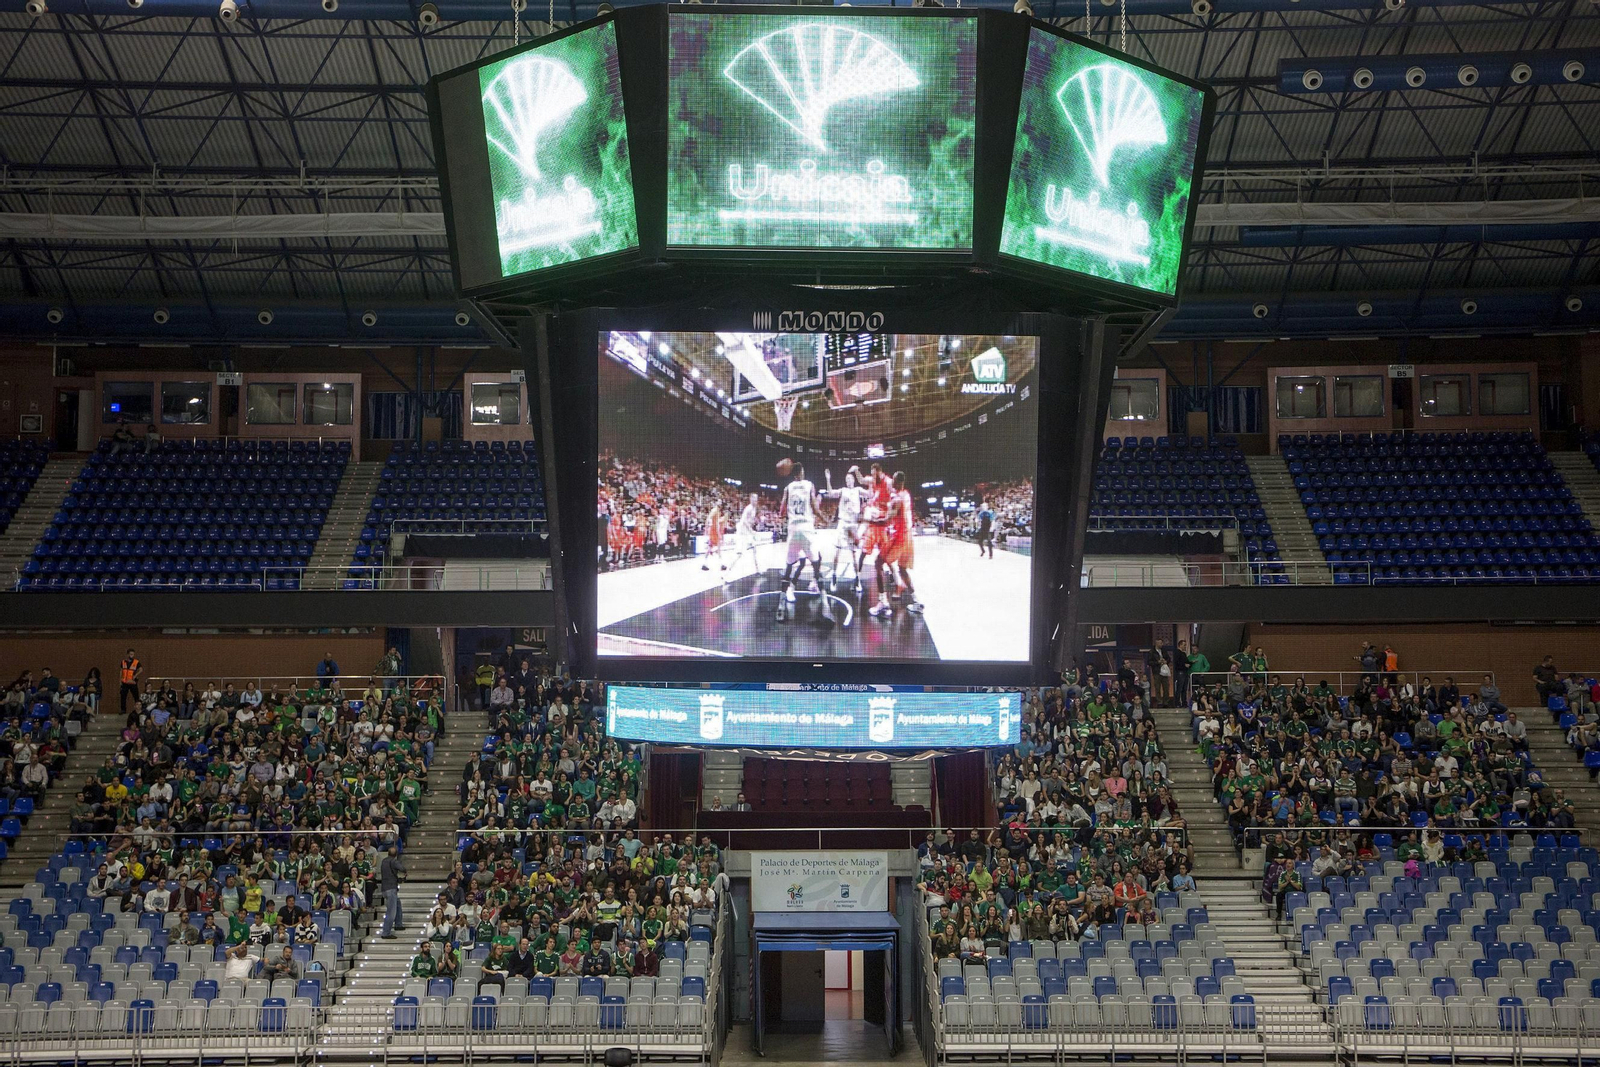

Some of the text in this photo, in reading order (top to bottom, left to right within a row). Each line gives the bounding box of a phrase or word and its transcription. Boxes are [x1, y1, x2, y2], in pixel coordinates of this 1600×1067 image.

[778, 311, 885, 332] MONDO
[961, 382, 1017, 394] ANDALUCÍA TV
[726, 711, 854, 726] Ayuntamiento de Málaga
[897, 713, 957, 726] Ayuntamiento
[760, 858, 880, 868] Palacio de Deportes de Málaga
[802, 868, 836, 876] Martín
[839, 868, 880, 877] Carpena
